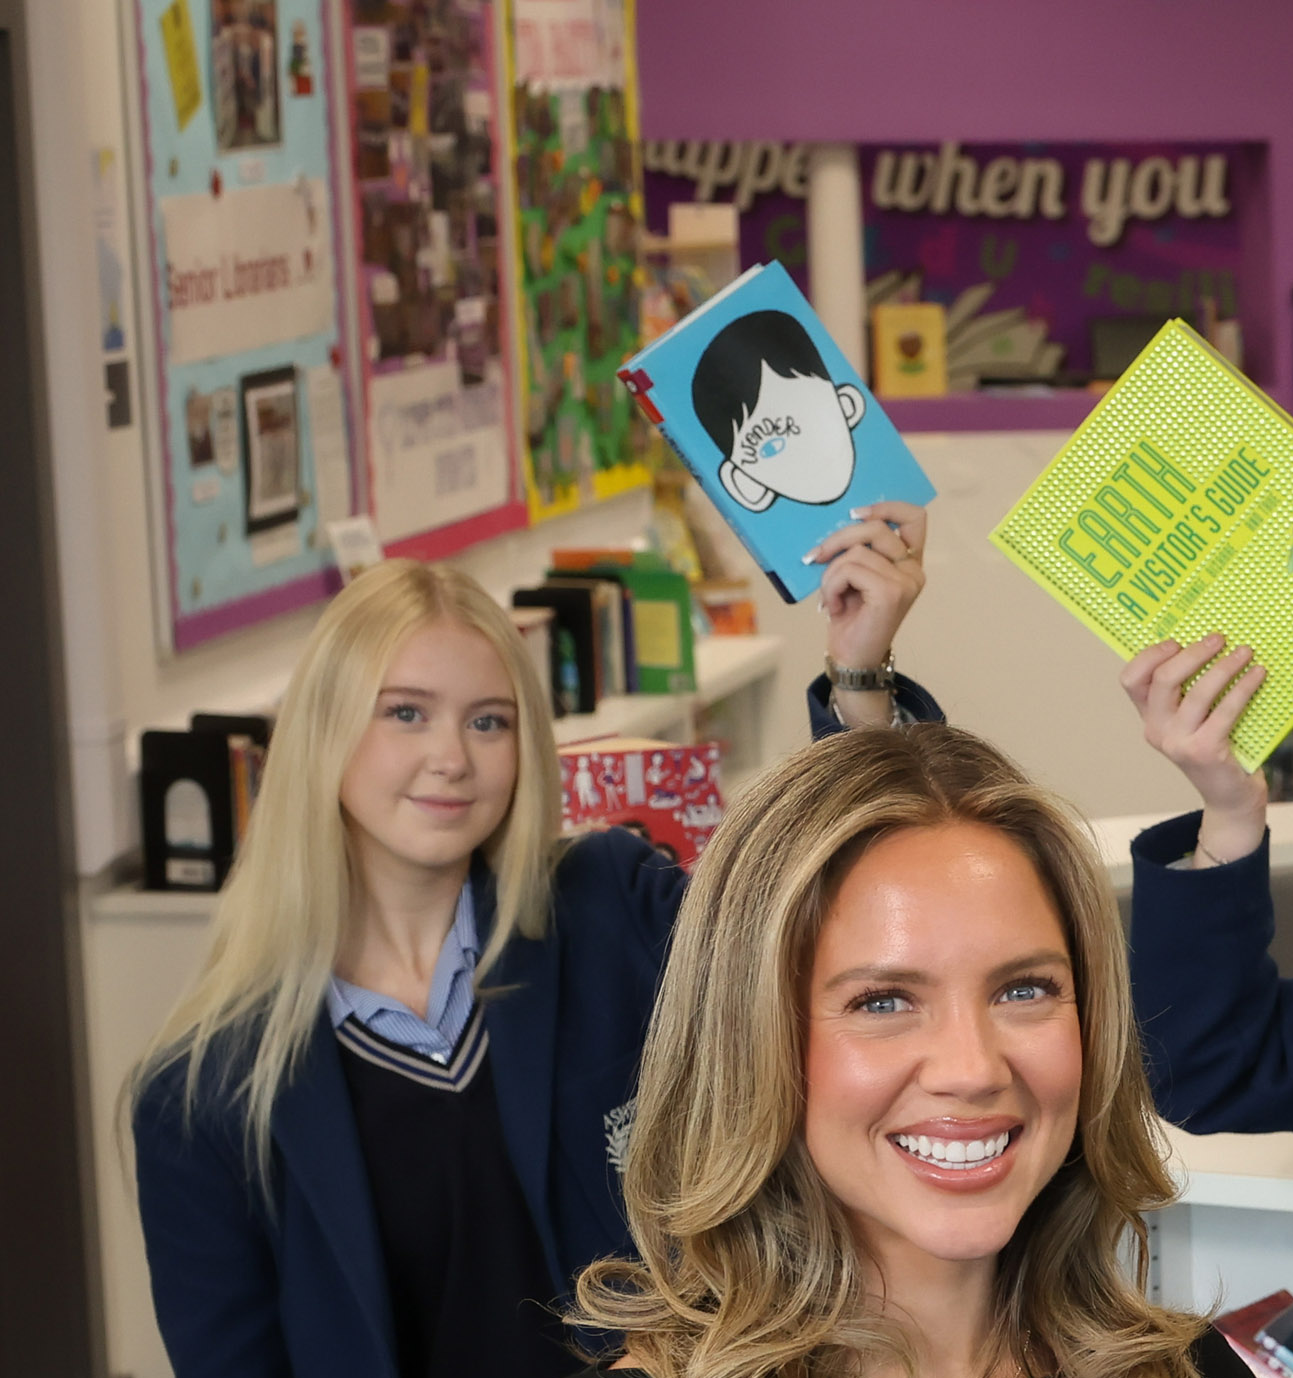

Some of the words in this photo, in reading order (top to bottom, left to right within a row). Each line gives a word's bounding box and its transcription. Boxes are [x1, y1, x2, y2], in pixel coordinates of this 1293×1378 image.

[871, 141, 1067, 218] when
[1080, 153, 1231, 246] you
[1058, 441, 1197, 589] EARTH
[1204, 446, 1271, 517] GUIDE
[1129, 504, 1222, 602] VISITOR'S
[1116, 591, 1149, 621] A
